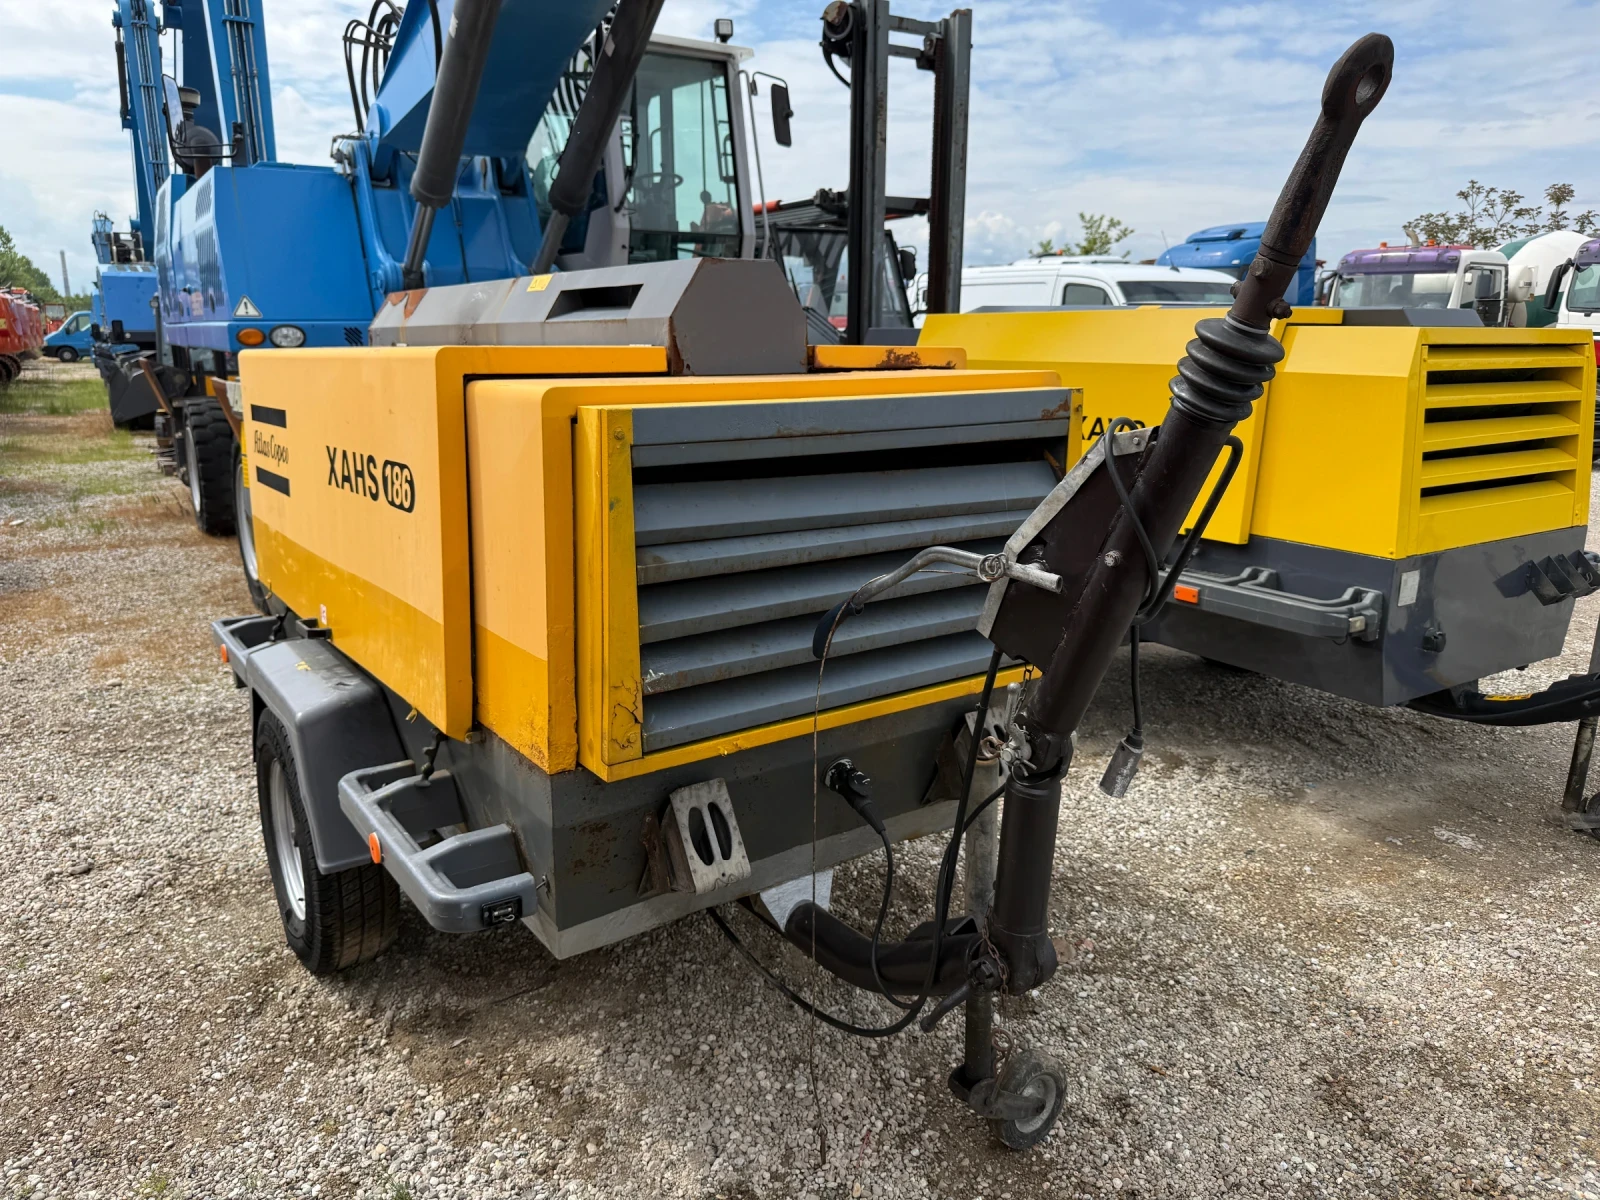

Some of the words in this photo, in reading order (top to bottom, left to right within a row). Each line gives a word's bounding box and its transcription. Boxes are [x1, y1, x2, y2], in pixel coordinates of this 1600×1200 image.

[254, 430, 270, 458] Atlas
[270, 435, 289, 467] Copco
[326, 445, 380, 502] XAHS
[384, 463, 412, 510] 186
